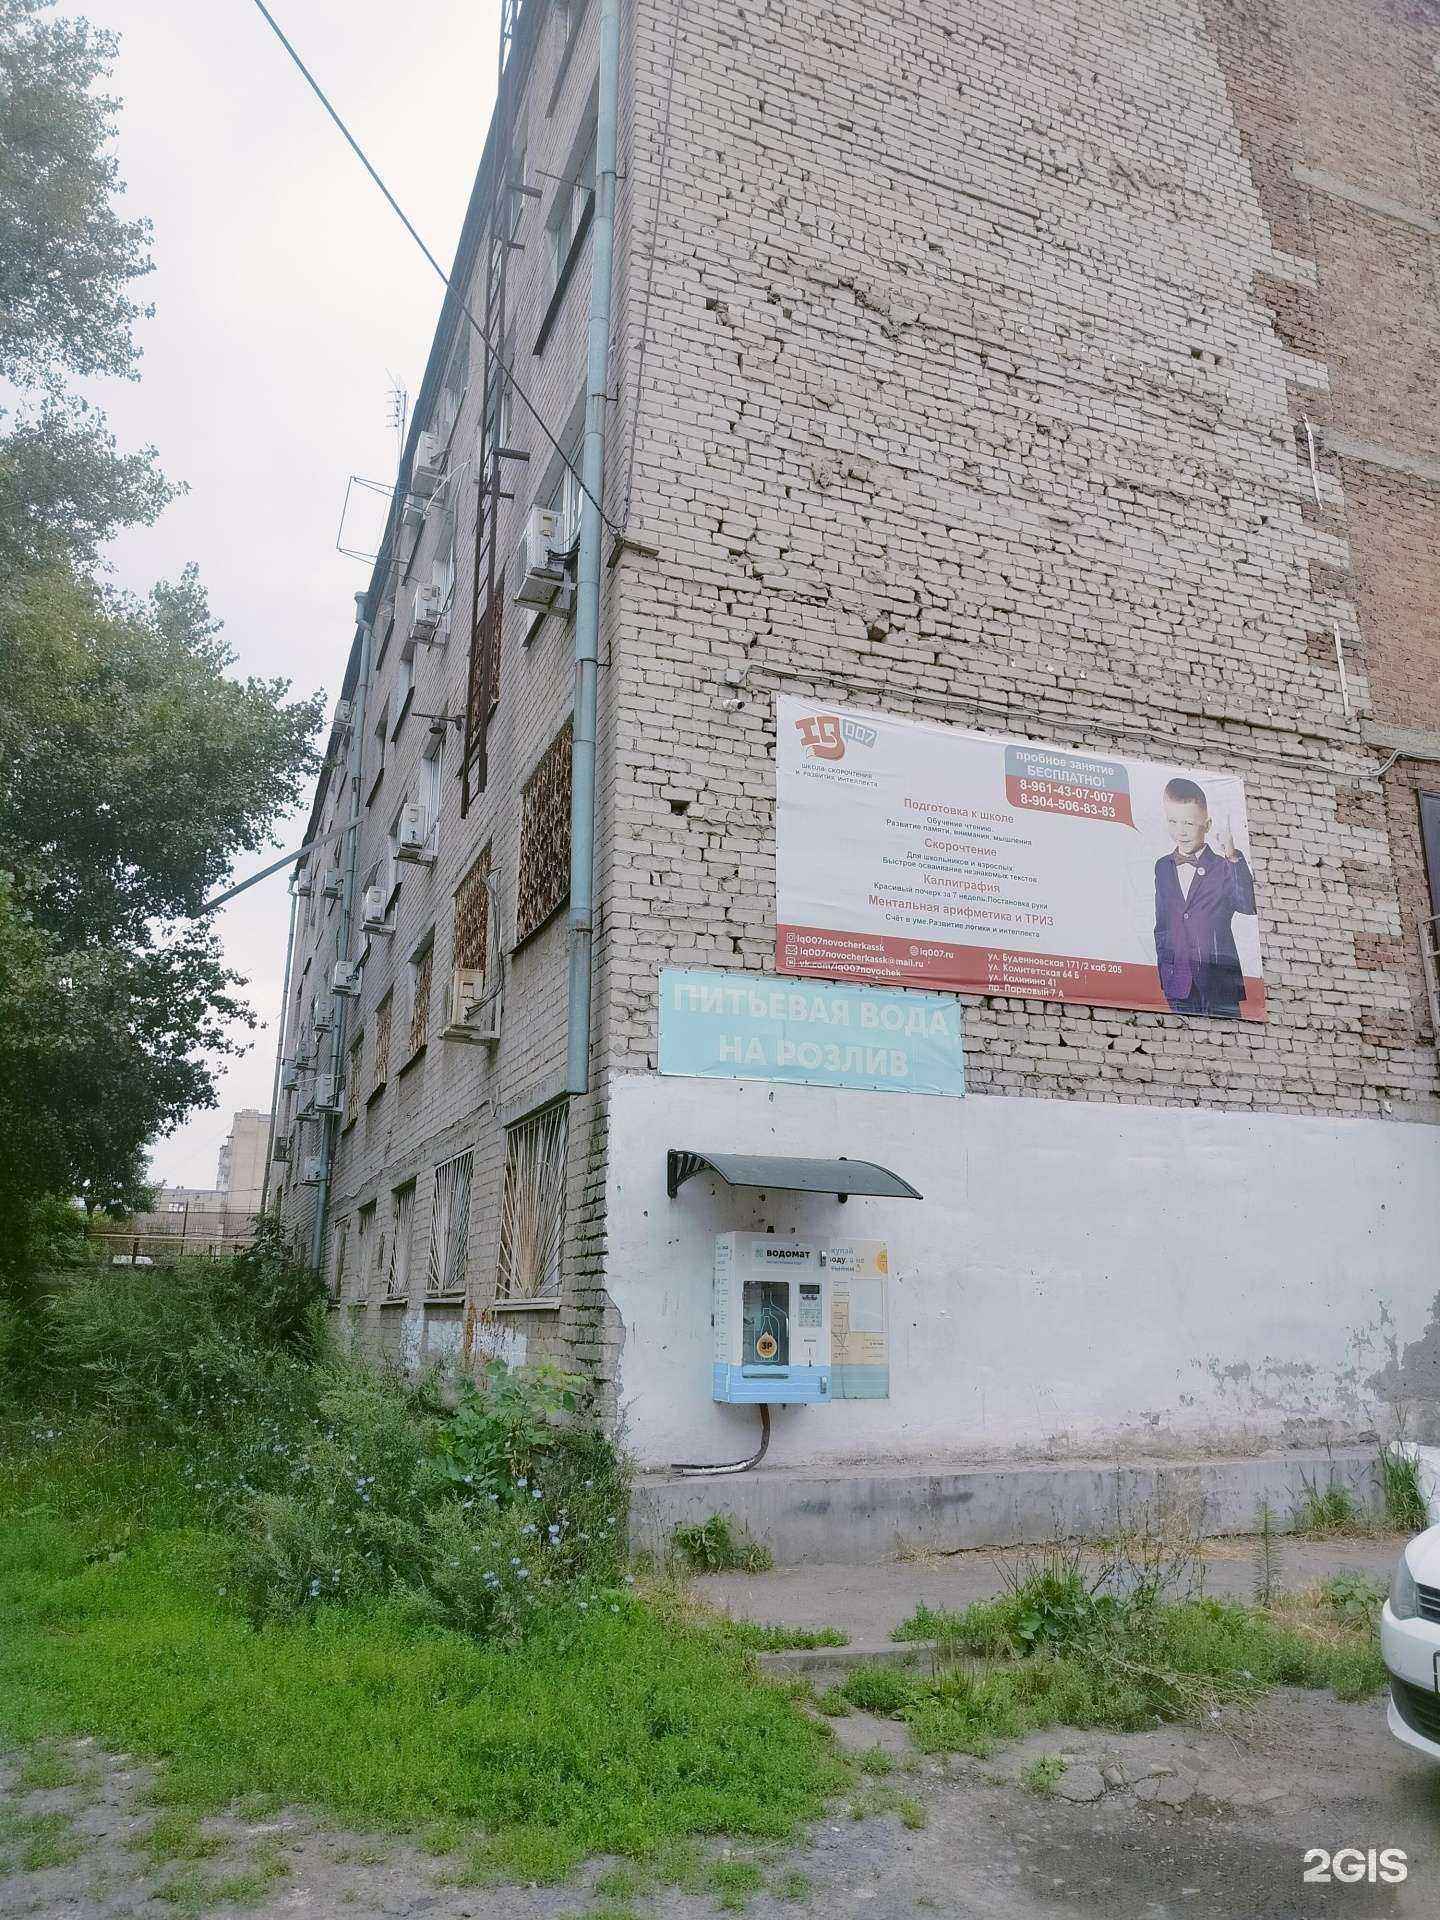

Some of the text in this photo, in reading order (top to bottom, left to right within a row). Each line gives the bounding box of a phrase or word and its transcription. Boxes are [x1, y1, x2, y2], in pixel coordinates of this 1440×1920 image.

[1016, 751, 1115, 776] пробное занятие
[1027, 765, 1106, 788] БЕСПЛАТНО!
[1019, 779, 1114, 804] 8-961-43-07-007
[904, 798, 1014, 824] Подготовка к школе
[1020, 793, 1116, 818] 8-904-506-83-83
[886, 818, 921, 830] Развитие
[926, 816, 963, 828] Обучение
[906, 851, 922, 860] Для
[924, 838, 997, 857] Скорочтение
[882, 856, 917, 867] Быстрое
[923, 874, 1000, 894] Каллиграфия
[868, 894, 1054, 926] Ментальная арифметика и ТРИЗ
[998, 927, 1040, 938] интеллекта
[987, 952, 1000, 962] ул.
[1108, 964, 1123, 974] 205
[988, 963, 1001, 972] ул.
[1003, 963, 1061, 977] Комитетская
[1063, 970, 1073, 979] 64
[988, 973, 1057, 987] ул. Калинина 41
[673, 982, 950, 1038] ПИТЬЕВАЯ ВОДА
[718, 1033, 909, 1078] НА РОЗЛИВ
[766, 1249, 811, 1259] водомат
